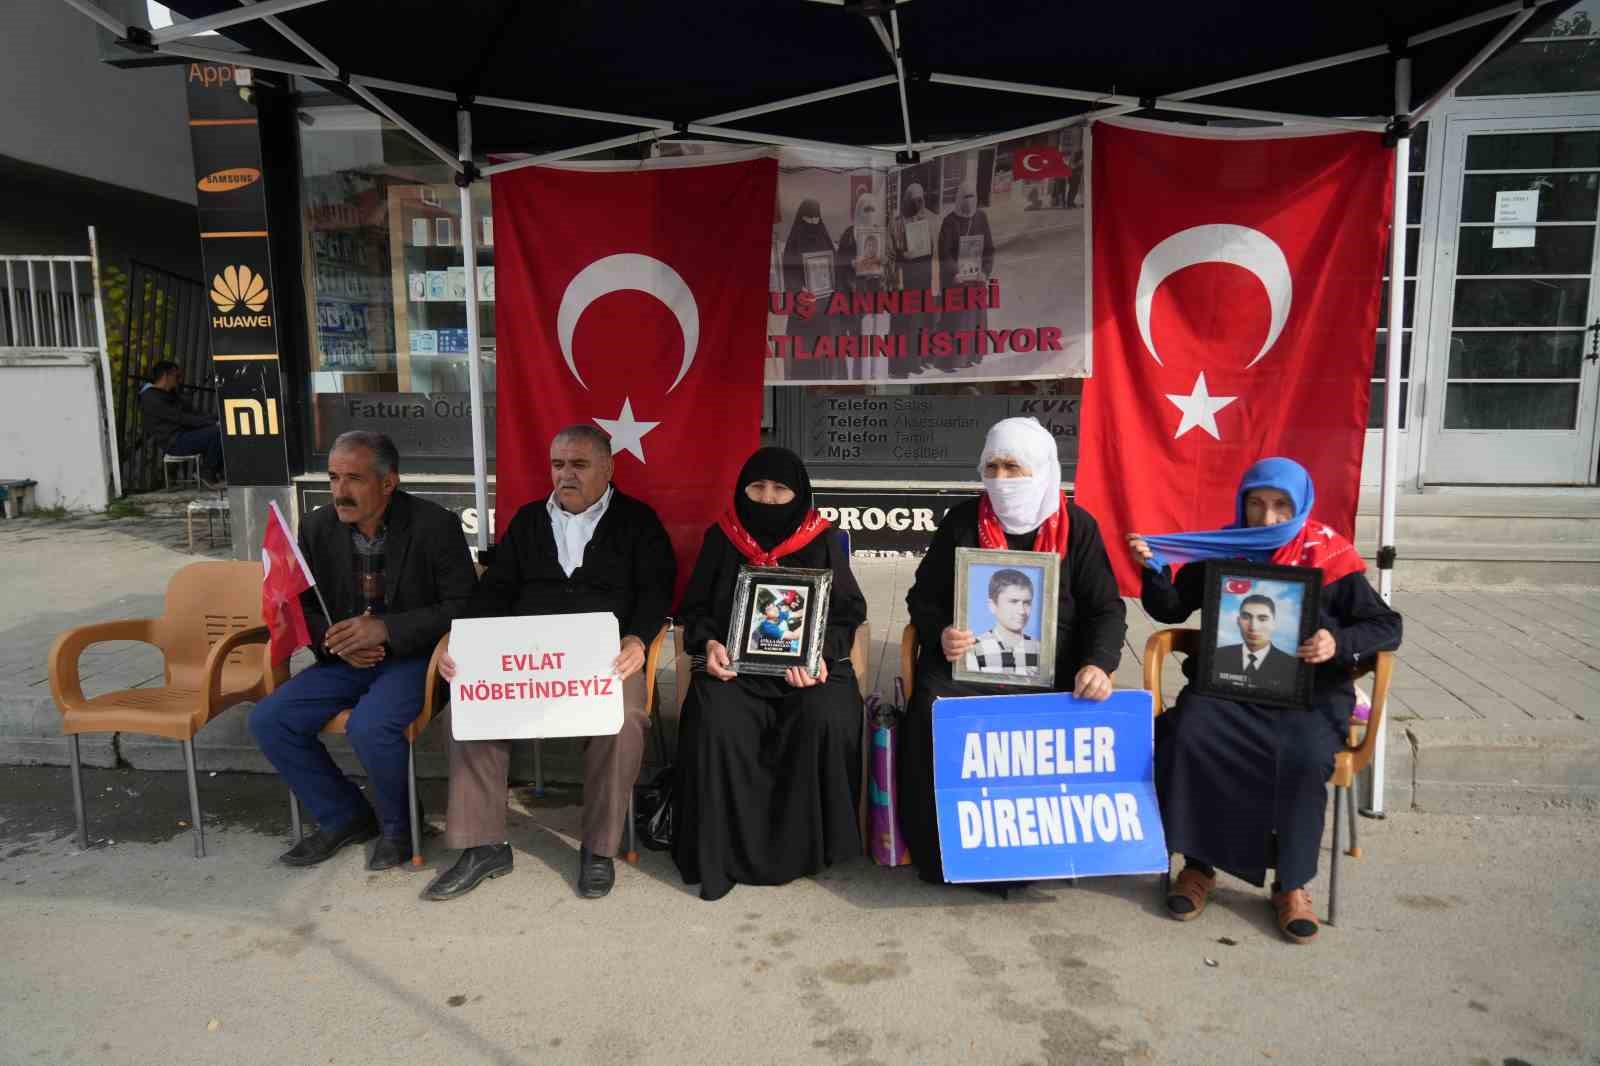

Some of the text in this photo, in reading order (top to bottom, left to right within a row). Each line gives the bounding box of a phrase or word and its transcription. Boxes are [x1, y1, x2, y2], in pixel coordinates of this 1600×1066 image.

[188, 63, 237, 88] Appl
[206, 173, 254, 185] SAMSUNG
[769, 279, 1001, 319] UŞ ANNELERİ
[212, 315, 272, 329] HUAWEI
[919, 324, 1064, 357] İSTİYOR
[349, 400, 424, 418] Fatura
[828, 399, 888, 411] Telefon
[1020, 399, 1078, 413] KVK
[828, 416, 888, 428] Telefon
[828, 431, 888, 443] Telefon
[828, 446, 861, 460] Mp3
[817, 506, 950, 532] PROGR
[501, 652, 566, 673] EVLAT
[459, 674, 614, 702] NÖBETİNDEYİZ
[961, 726, 1117, 780] ANNELER
[957, 783, 1145, 850] DİRENİYOR
